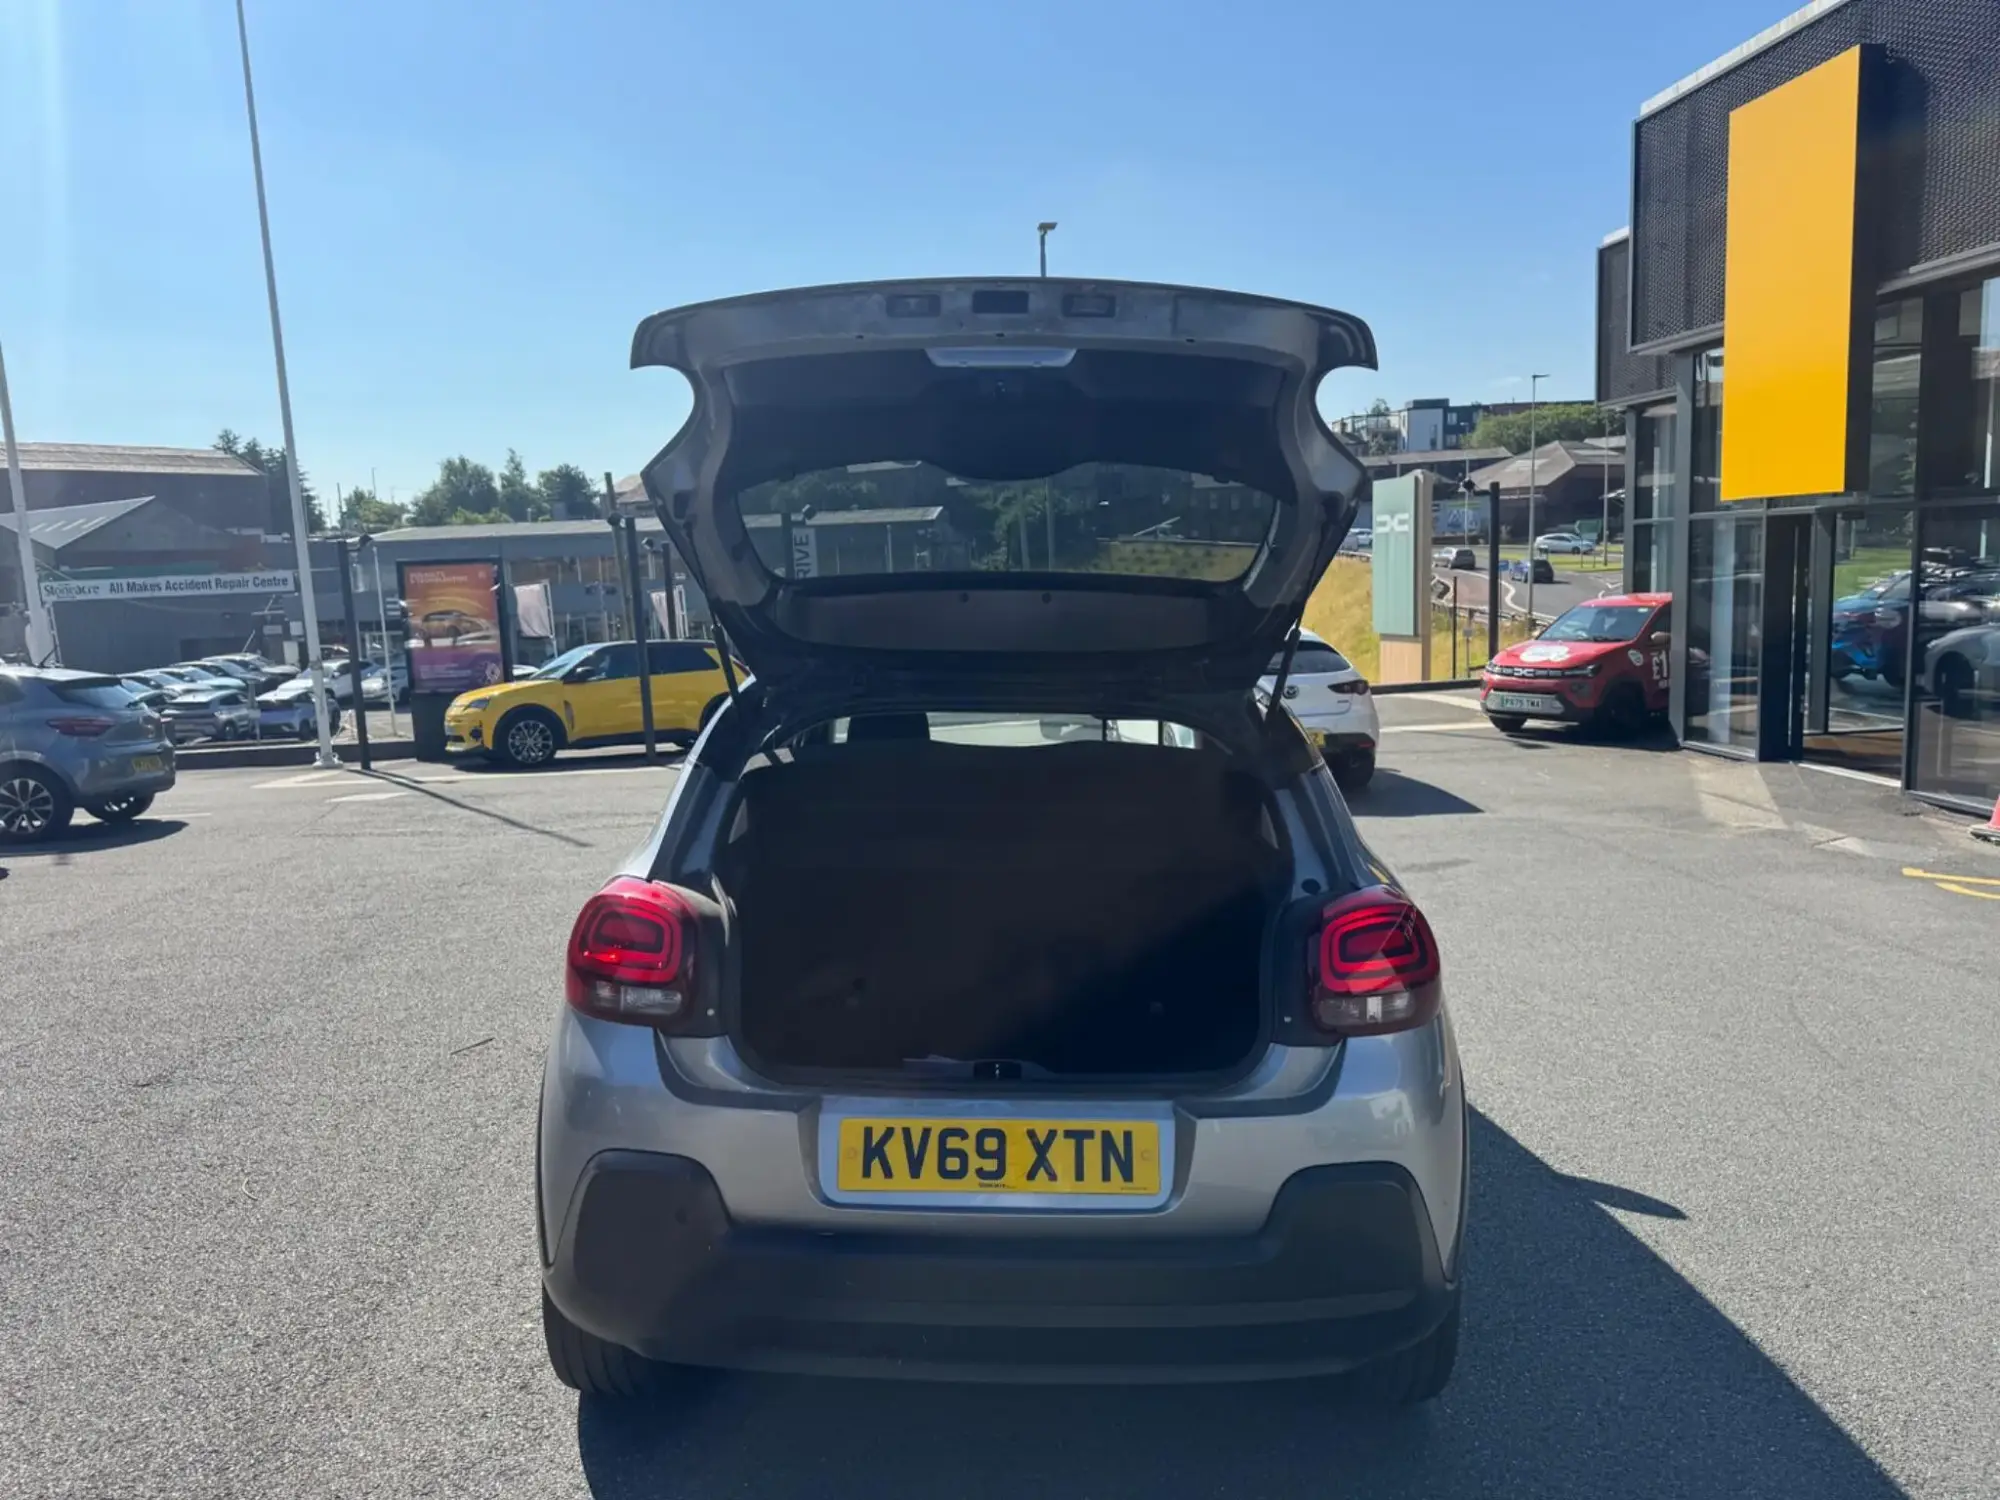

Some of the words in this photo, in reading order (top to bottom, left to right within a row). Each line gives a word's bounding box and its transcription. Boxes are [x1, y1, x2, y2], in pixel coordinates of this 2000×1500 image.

[109, 582, 124, 595] All
[127, 580, 162, 593] Makes
[165, 578, 212, 591] Accident
[215, 577, 250, 590] Repair
[253, 575, 288, 588] Centre
[862, 1126, 1007, 1181] KV69
[1026, 1128, 1133, 1183] XTN
